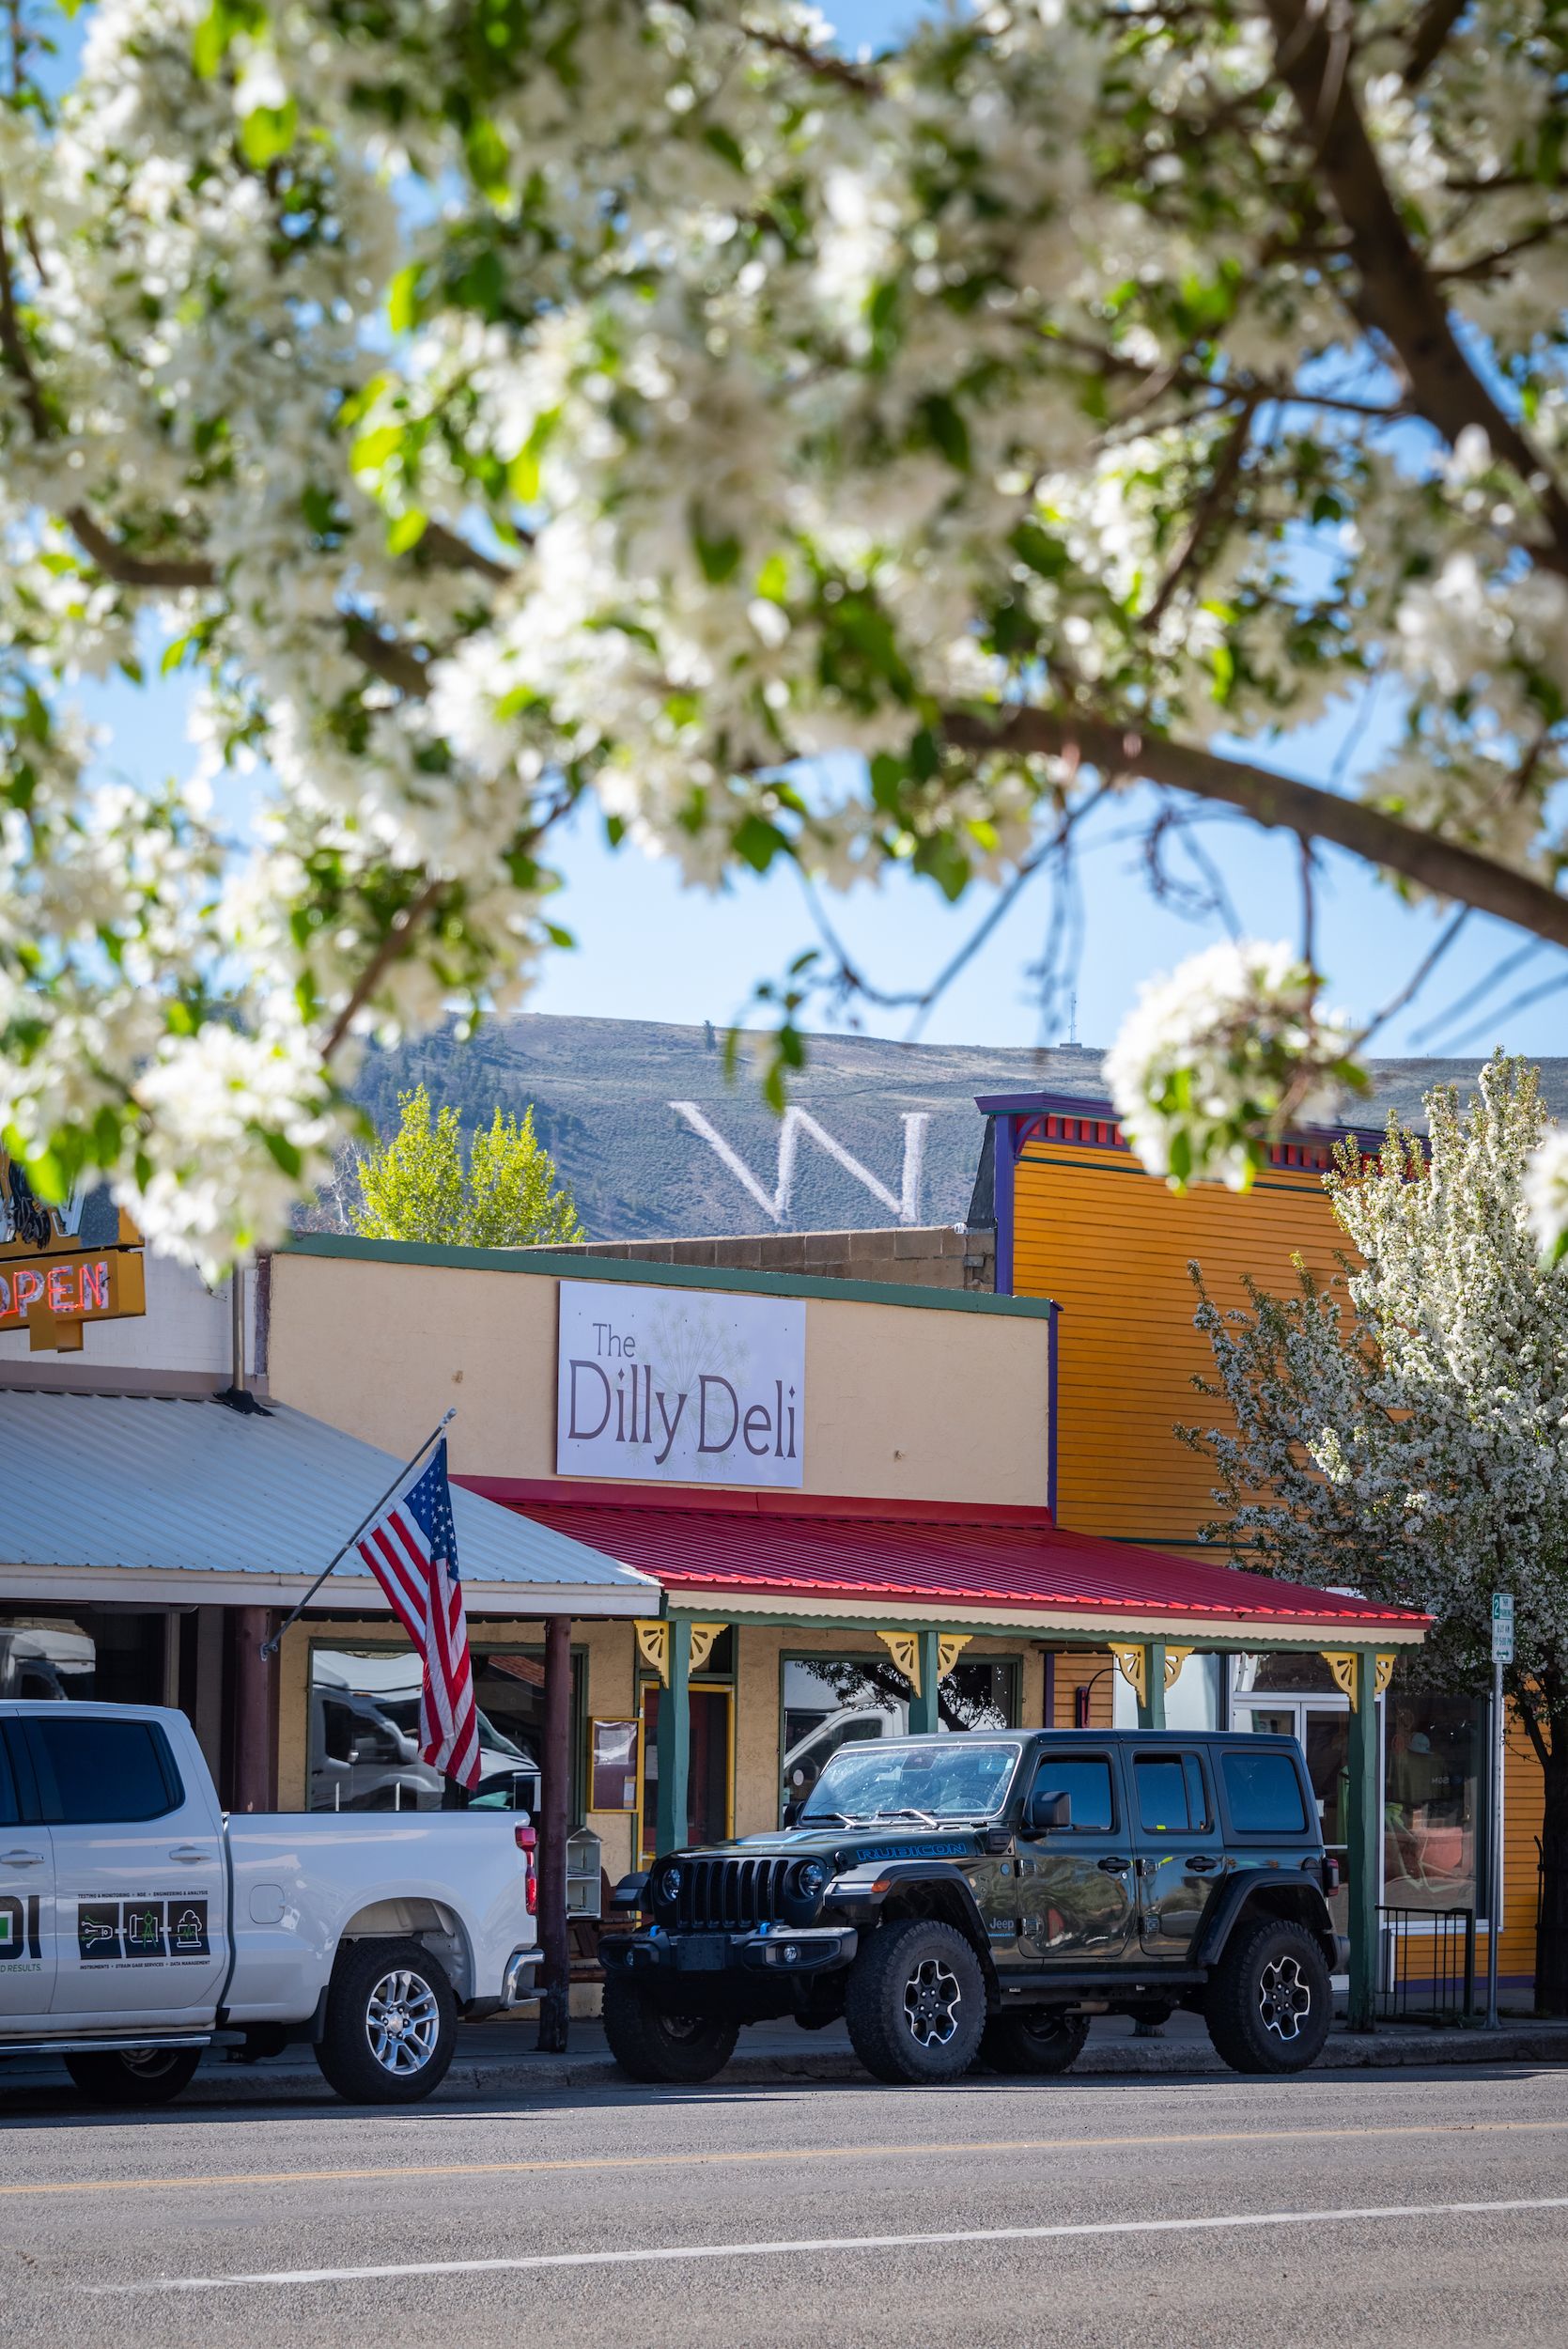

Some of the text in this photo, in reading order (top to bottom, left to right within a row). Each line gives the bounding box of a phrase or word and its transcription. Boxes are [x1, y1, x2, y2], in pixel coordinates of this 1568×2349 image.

[592, 1323, 636, 1358] The
[568, 1360, 797, 1465] Dilly Deli
[1495, 1599, 1499, 1615] 2
[857, 1843, 967, 1860] RUBICON
[989, 1917, 1015, 1931] Jeep
